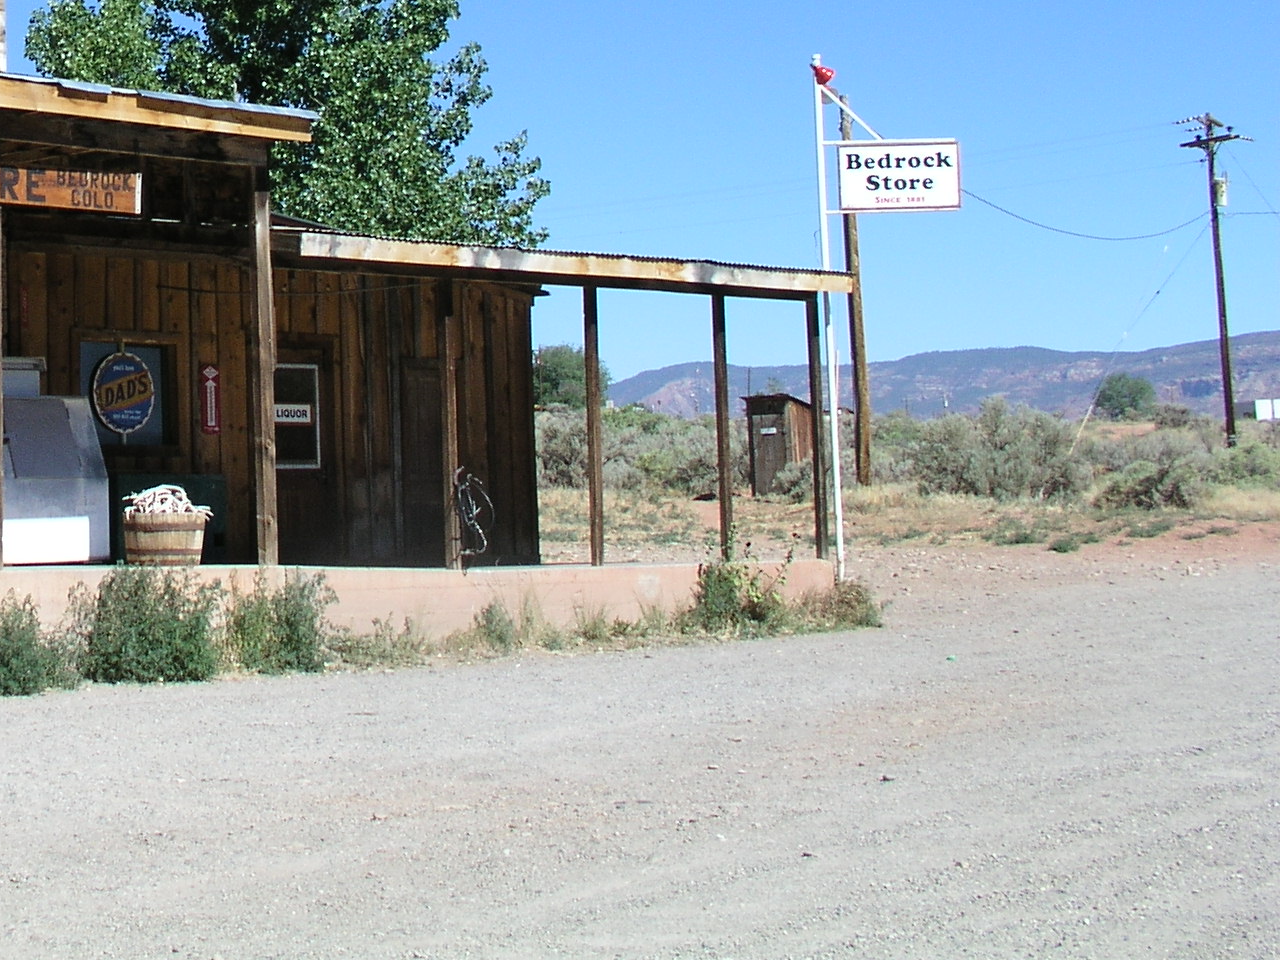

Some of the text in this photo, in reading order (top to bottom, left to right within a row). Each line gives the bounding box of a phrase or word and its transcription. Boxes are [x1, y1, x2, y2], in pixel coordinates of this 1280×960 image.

[846, 152, 953, 170] Bedrock
[56, 170, 136, 192] BEDROCK
[866, 174, 934, 191] Store
[71, 188, 119, 211] COLO.
[105, 375, 149, 406] DAD'S
[276, 408, 308, 419] LIQUOR
